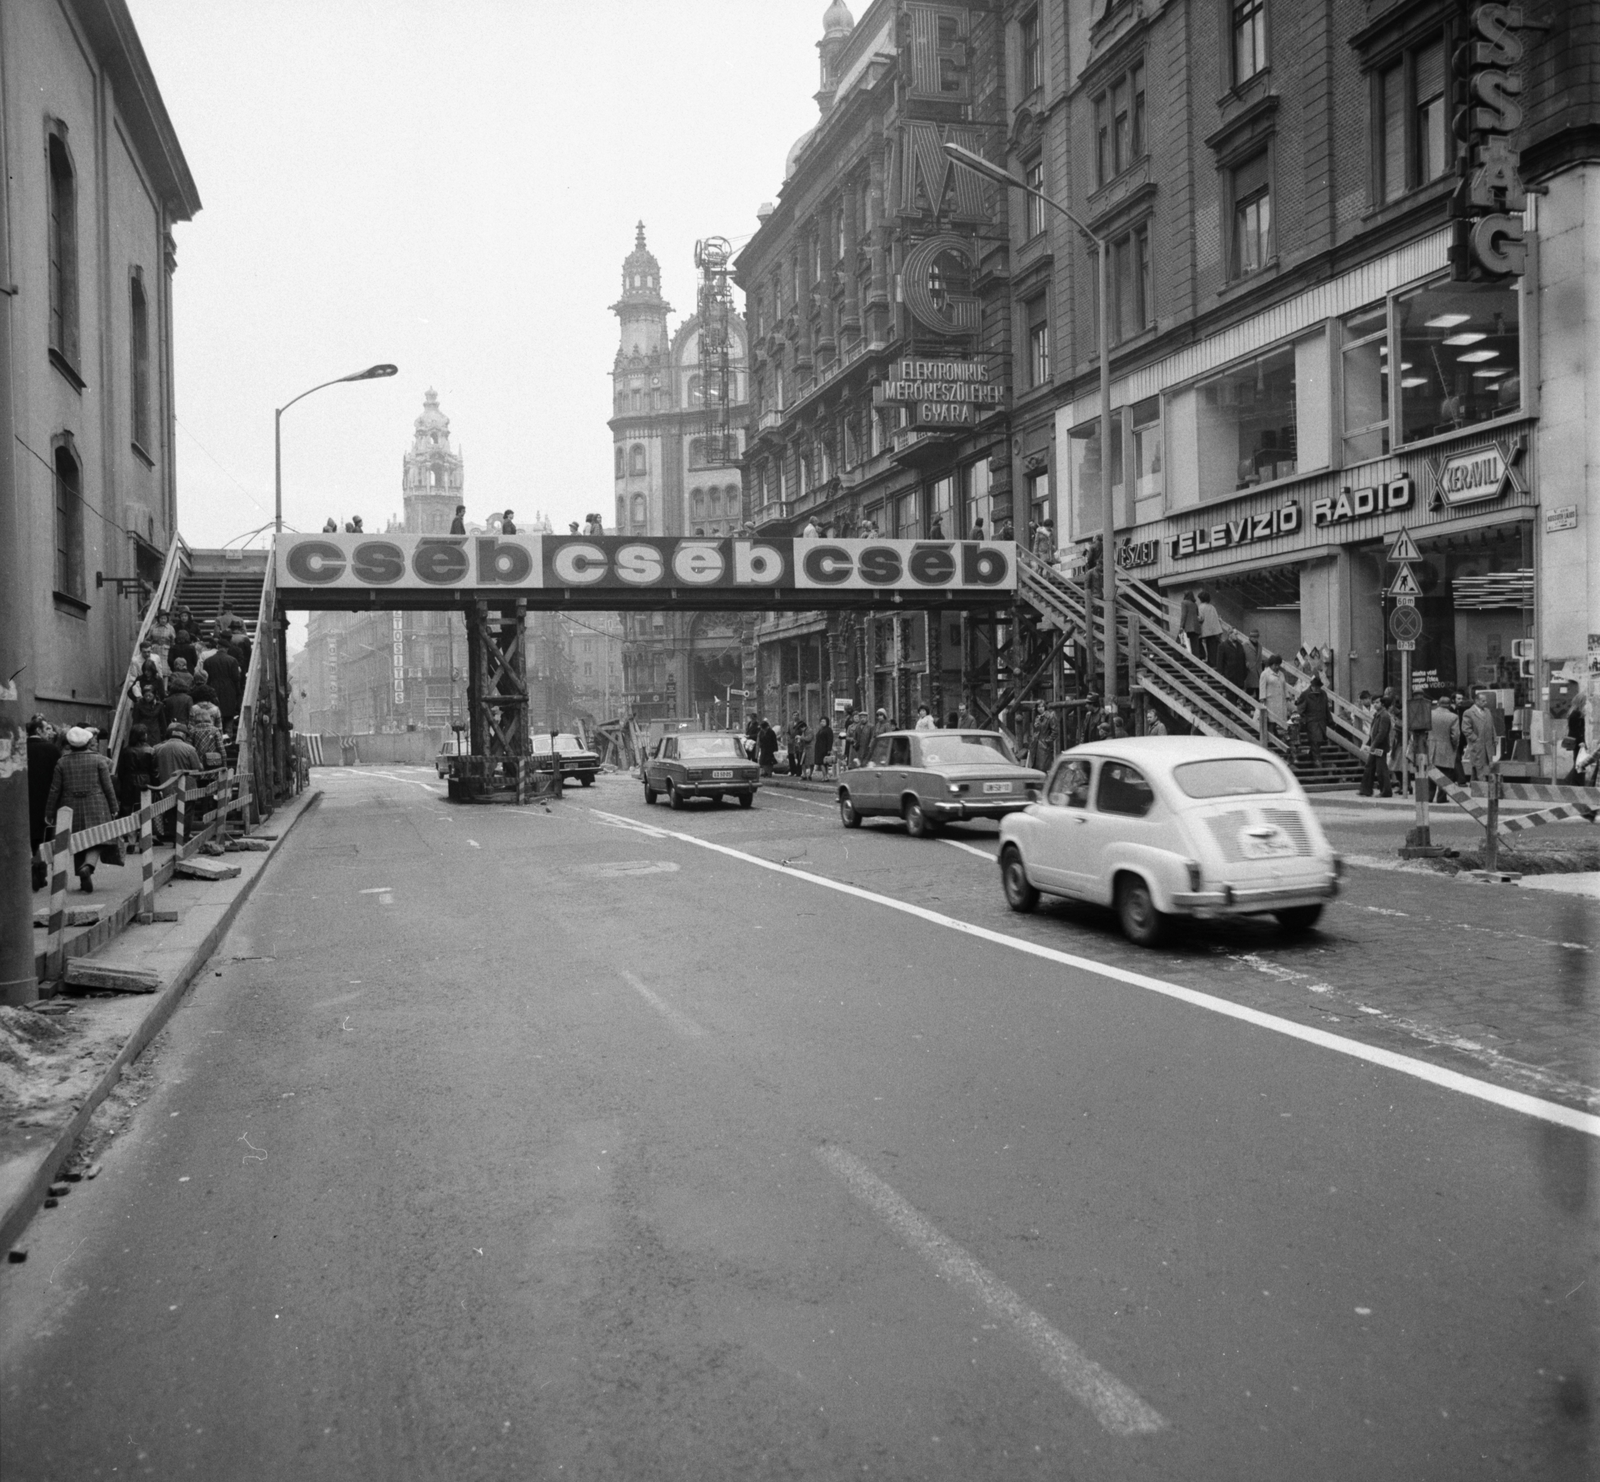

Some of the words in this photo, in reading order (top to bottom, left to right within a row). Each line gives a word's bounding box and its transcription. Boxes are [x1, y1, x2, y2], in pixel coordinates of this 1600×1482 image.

[902, 361, 989, 382] ELEKTRONIKUS
[922, 403, 970, 423] GYÁRA
[1446, 456, 1500, 493] KERAVILL
[1311, 473, 1412, 526] RÁDIÓ
